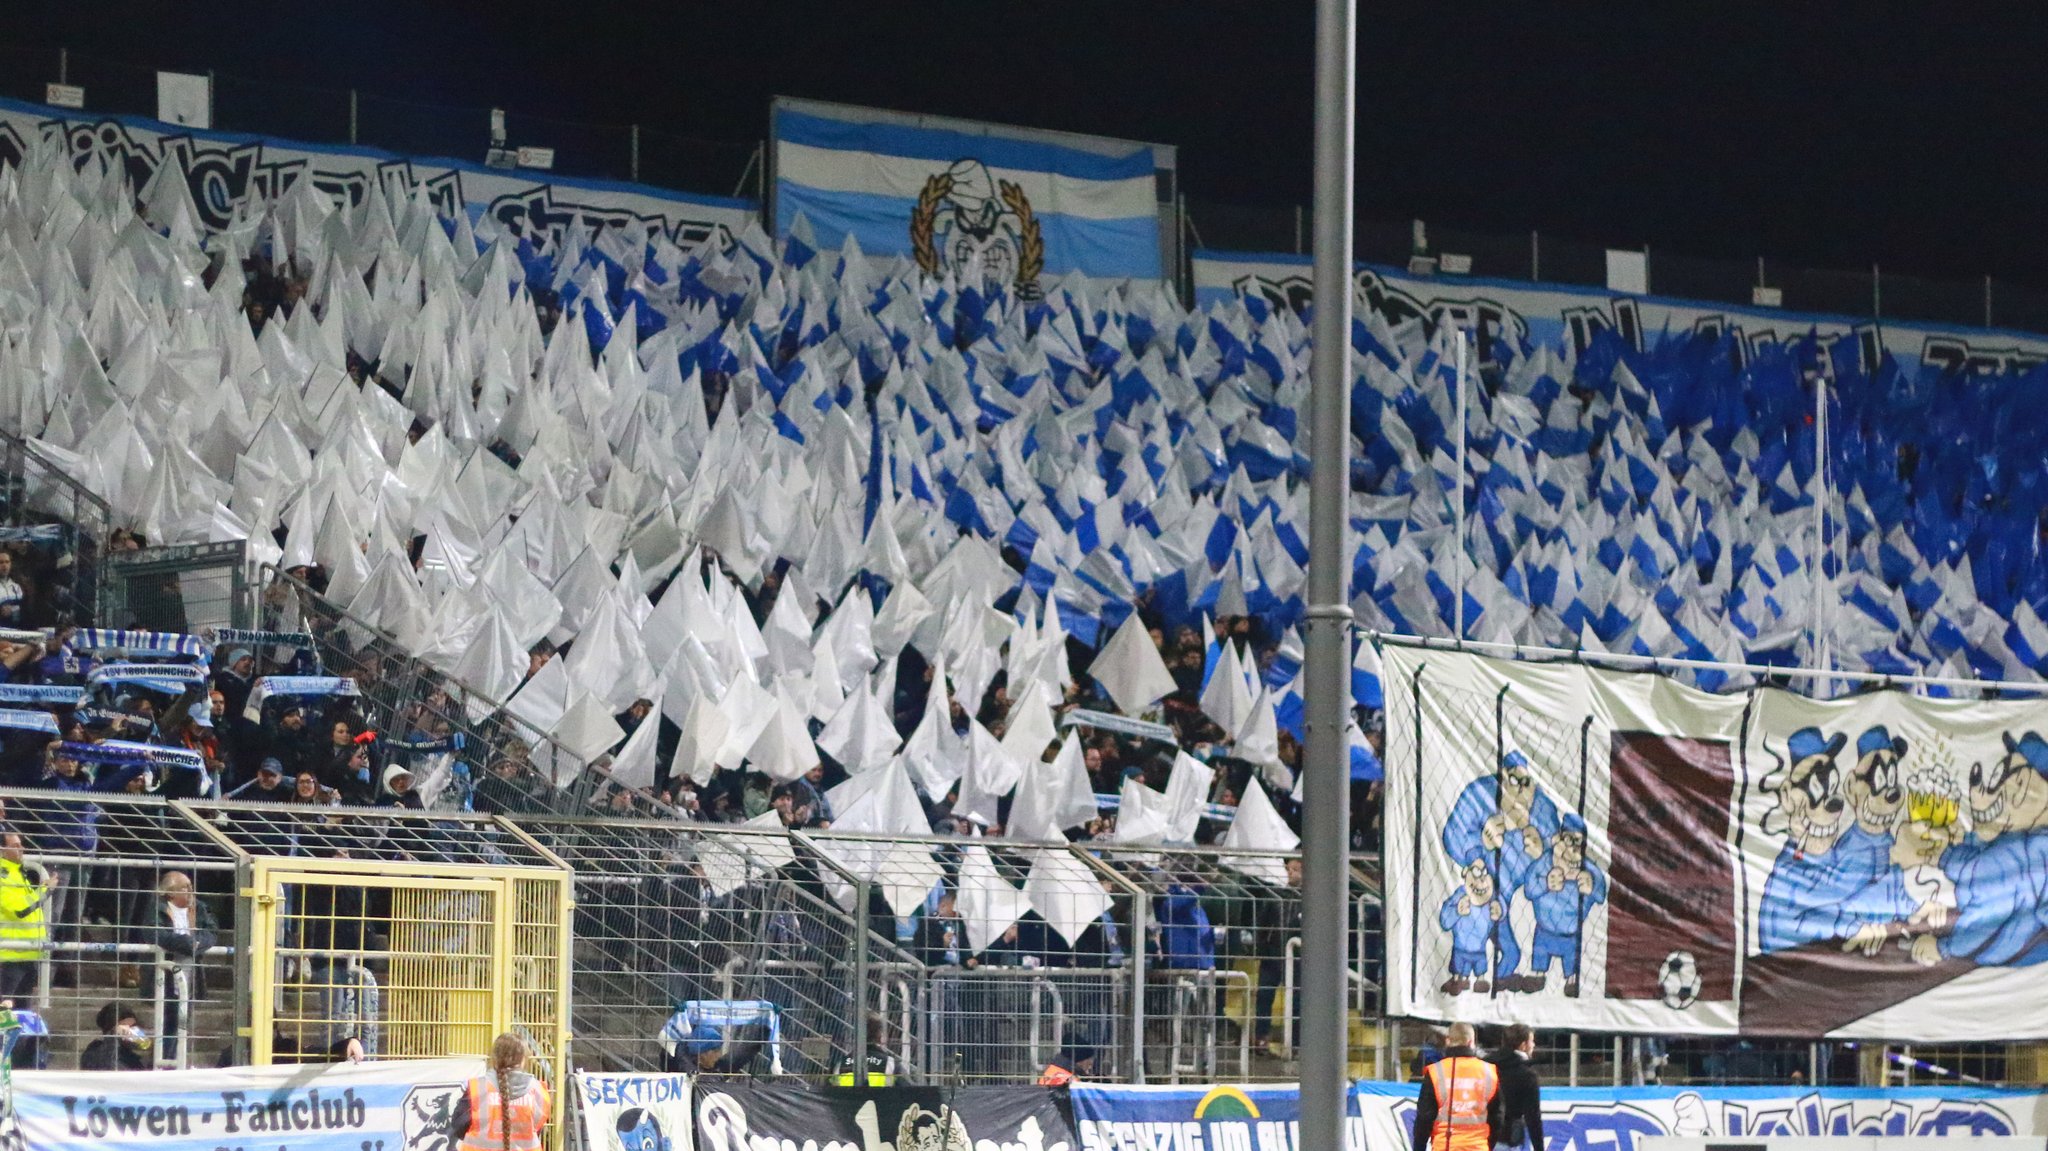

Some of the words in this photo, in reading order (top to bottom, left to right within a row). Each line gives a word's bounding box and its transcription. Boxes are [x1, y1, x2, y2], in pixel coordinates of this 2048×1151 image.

[148, 666, 197, 677] MÜNCHEN
[152, 749, 201, 766] MÜNCHEN
[586, 1076, 684, 1106] SEKTION
[62, 1095, 191, 1138] Löwen
[220, 1088, 366, 1134] Fanclub
